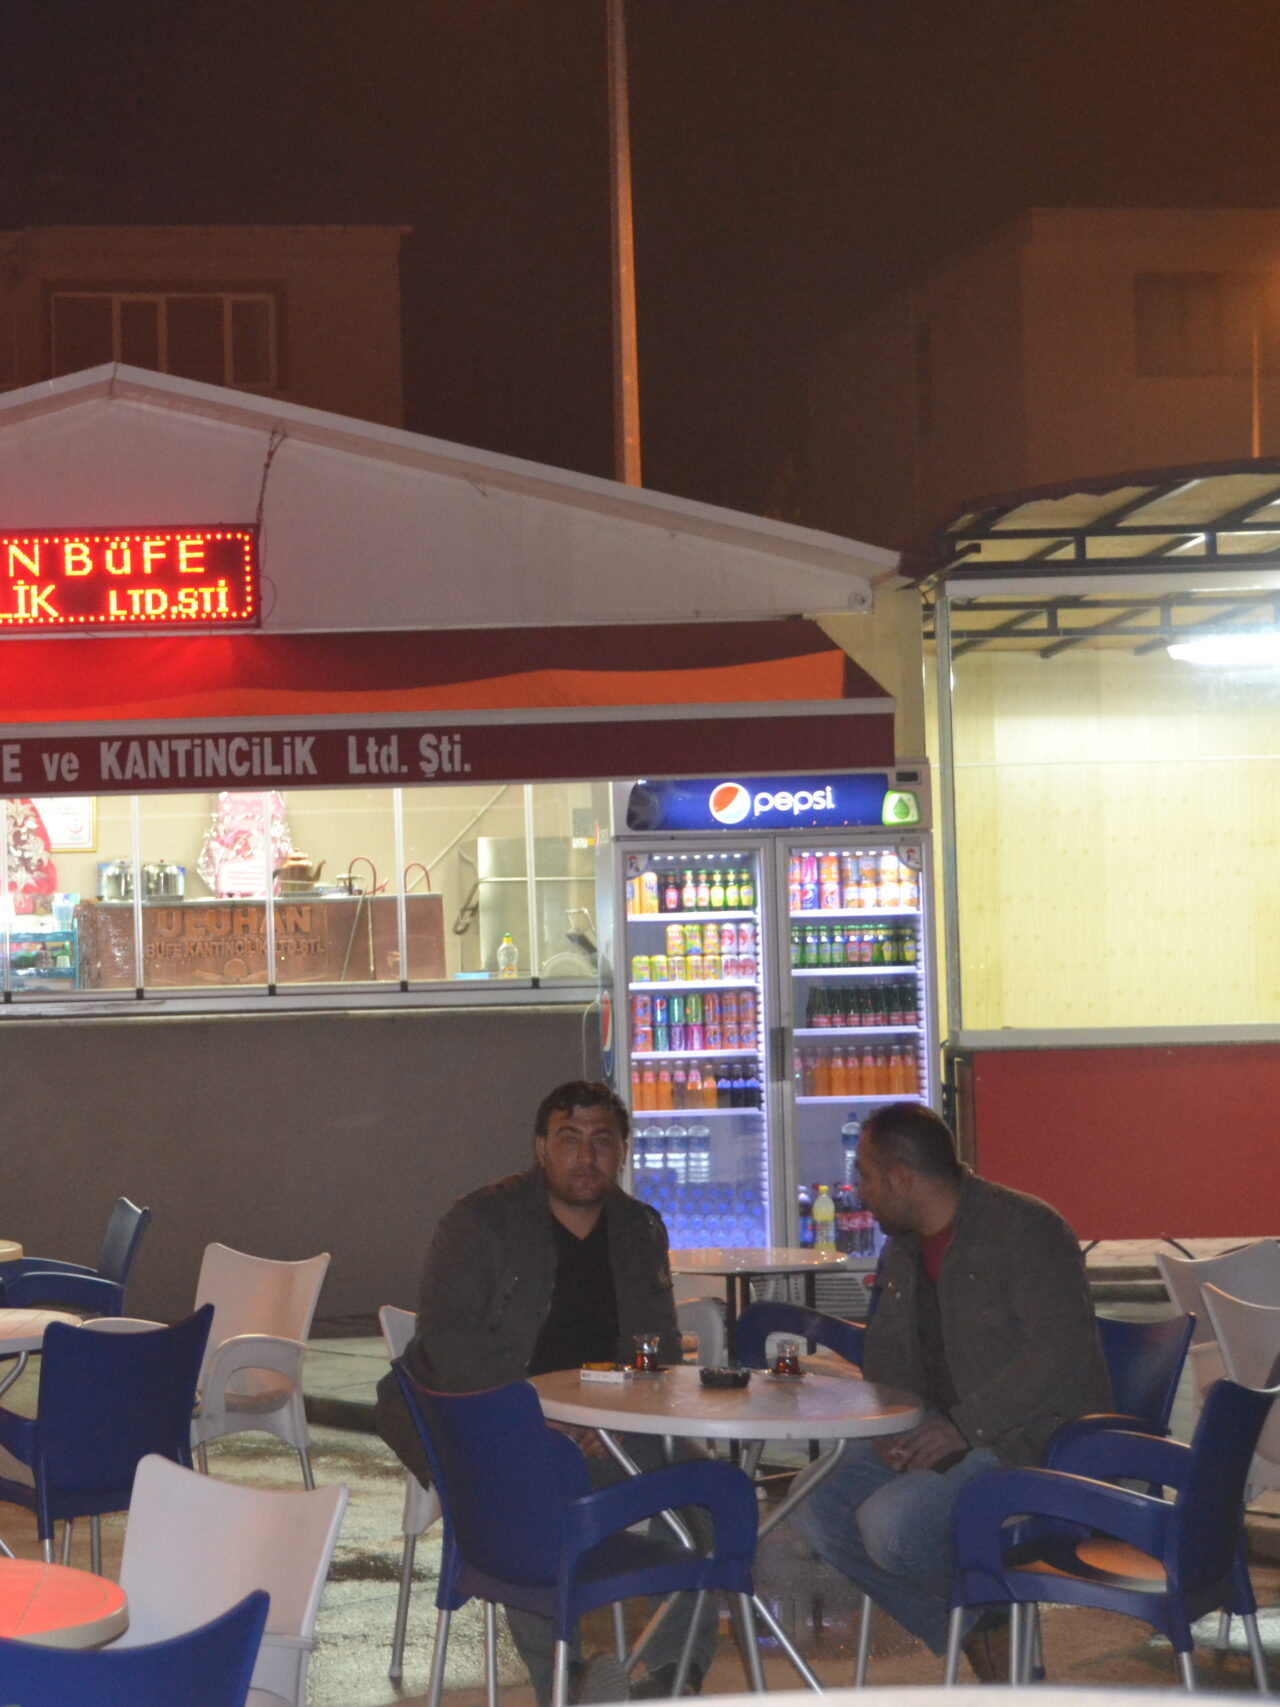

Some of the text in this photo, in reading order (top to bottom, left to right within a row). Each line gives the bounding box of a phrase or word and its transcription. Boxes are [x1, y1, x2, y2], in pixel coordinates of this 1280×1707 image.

[42, 751, 80, 782] ve
[347, 734, 409, 774] Ltd.
[419, 733, 472, 778] Şti.
[753, 786, 836, 817] pepsi
[156, 906, 313, 938] ULUHAN
